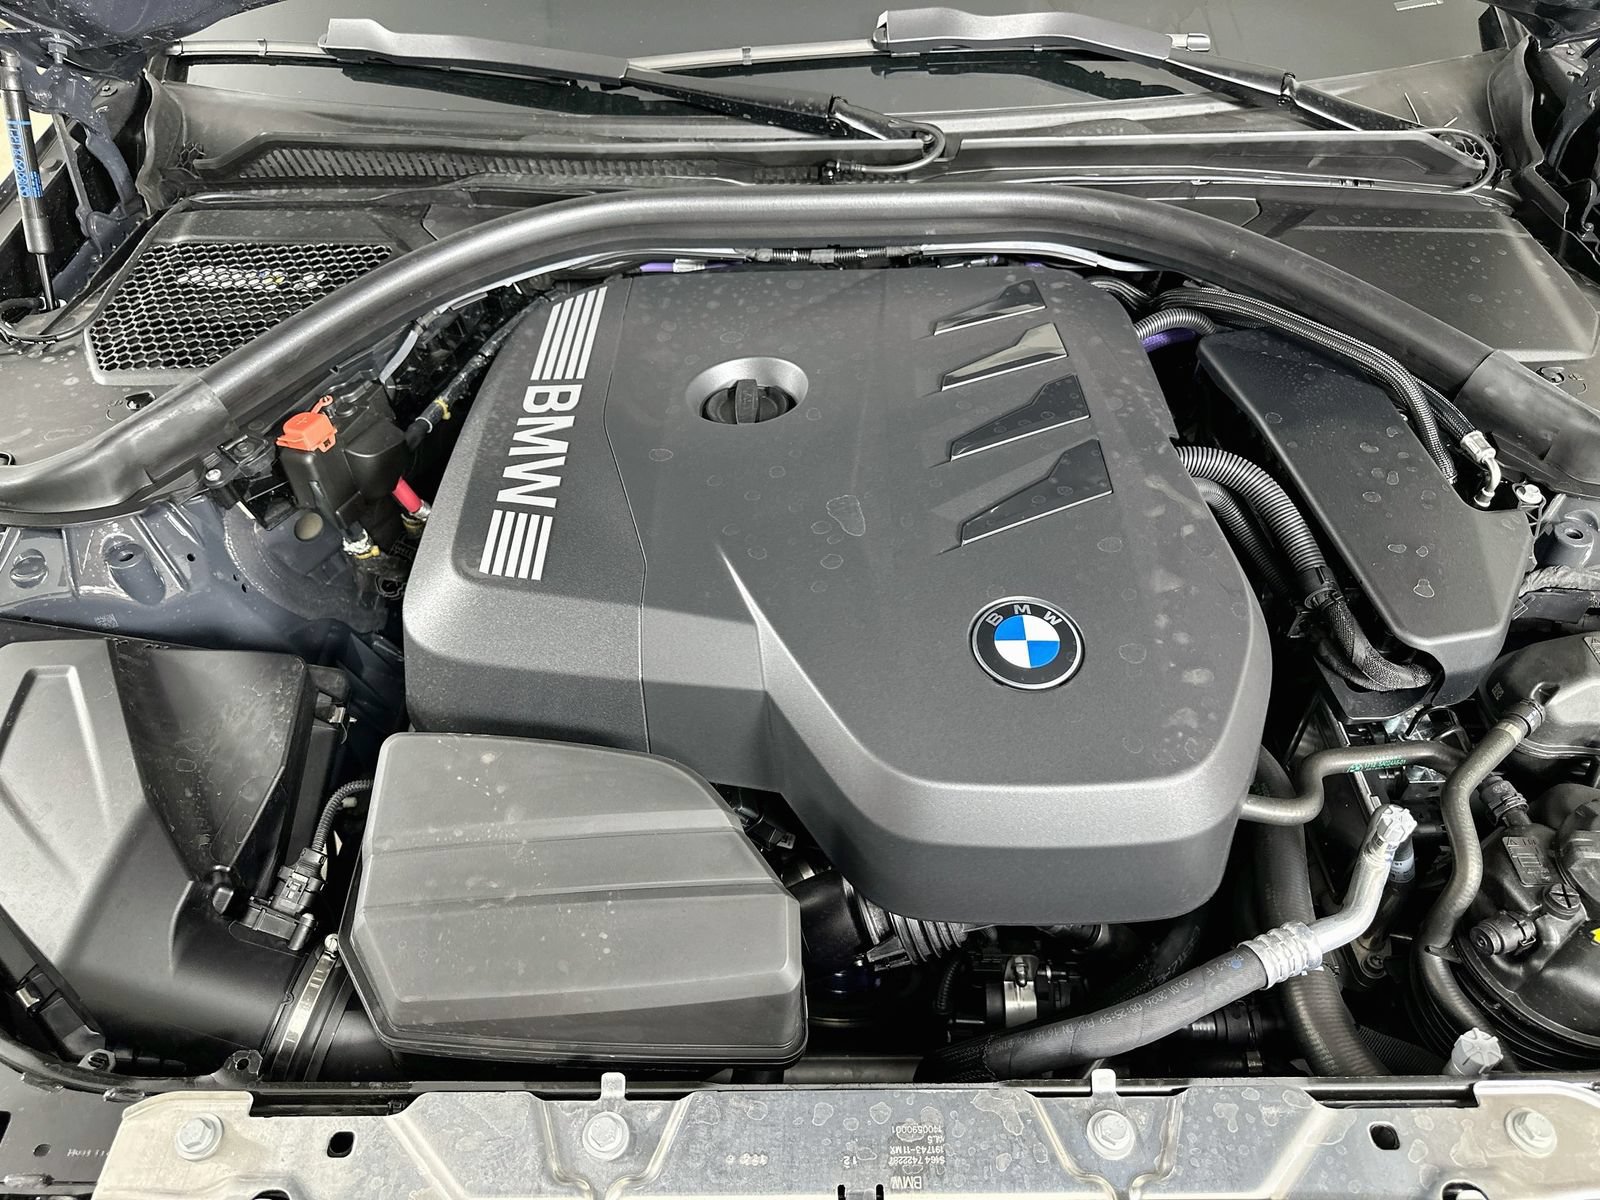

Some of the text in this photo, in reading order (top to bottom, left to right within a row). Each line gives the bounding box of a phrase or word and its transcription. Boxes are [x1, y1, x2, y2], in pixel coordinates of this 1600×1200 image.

[496, 384, 583, 509] BMW
[985, 604, 1062, 627] BMW
[1145, 977, 1193, 1007] 20.01.2026
[1100, 1003, 1143, 1025] 08:25:59
[890, 1175, 922, 1189] BMW
